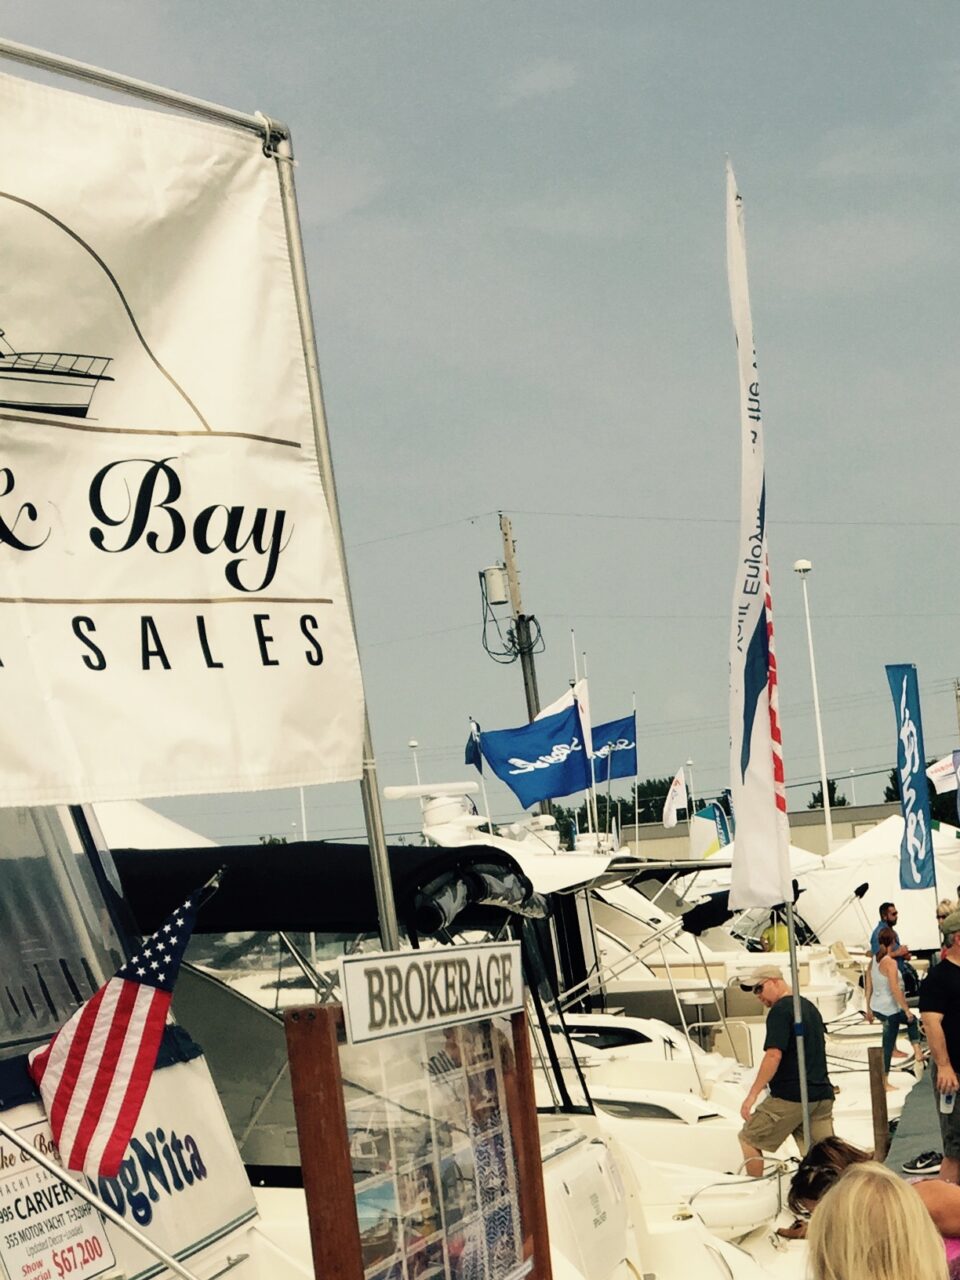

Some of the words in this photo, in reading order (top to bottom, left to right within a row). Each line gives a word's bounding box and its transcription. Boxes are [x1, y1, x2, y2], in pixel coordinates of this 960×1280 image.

[0, 467, 51, 551] &
[88, 456, 295, 592] Bay
[71, 613, 324, 671] SALES
[363, 953, 514, 1032] BROKERAGE
[87, 1127, 207, 1227] ogNita
[4, 1232, 20, 1249] 355
[18, 1222, 46, 1244] MOTOR
[43, 1213, 66, 1232] YACHT
[21, 1258, 44, 1277] Show
[52, 1235, 103, 1280] $67,200
